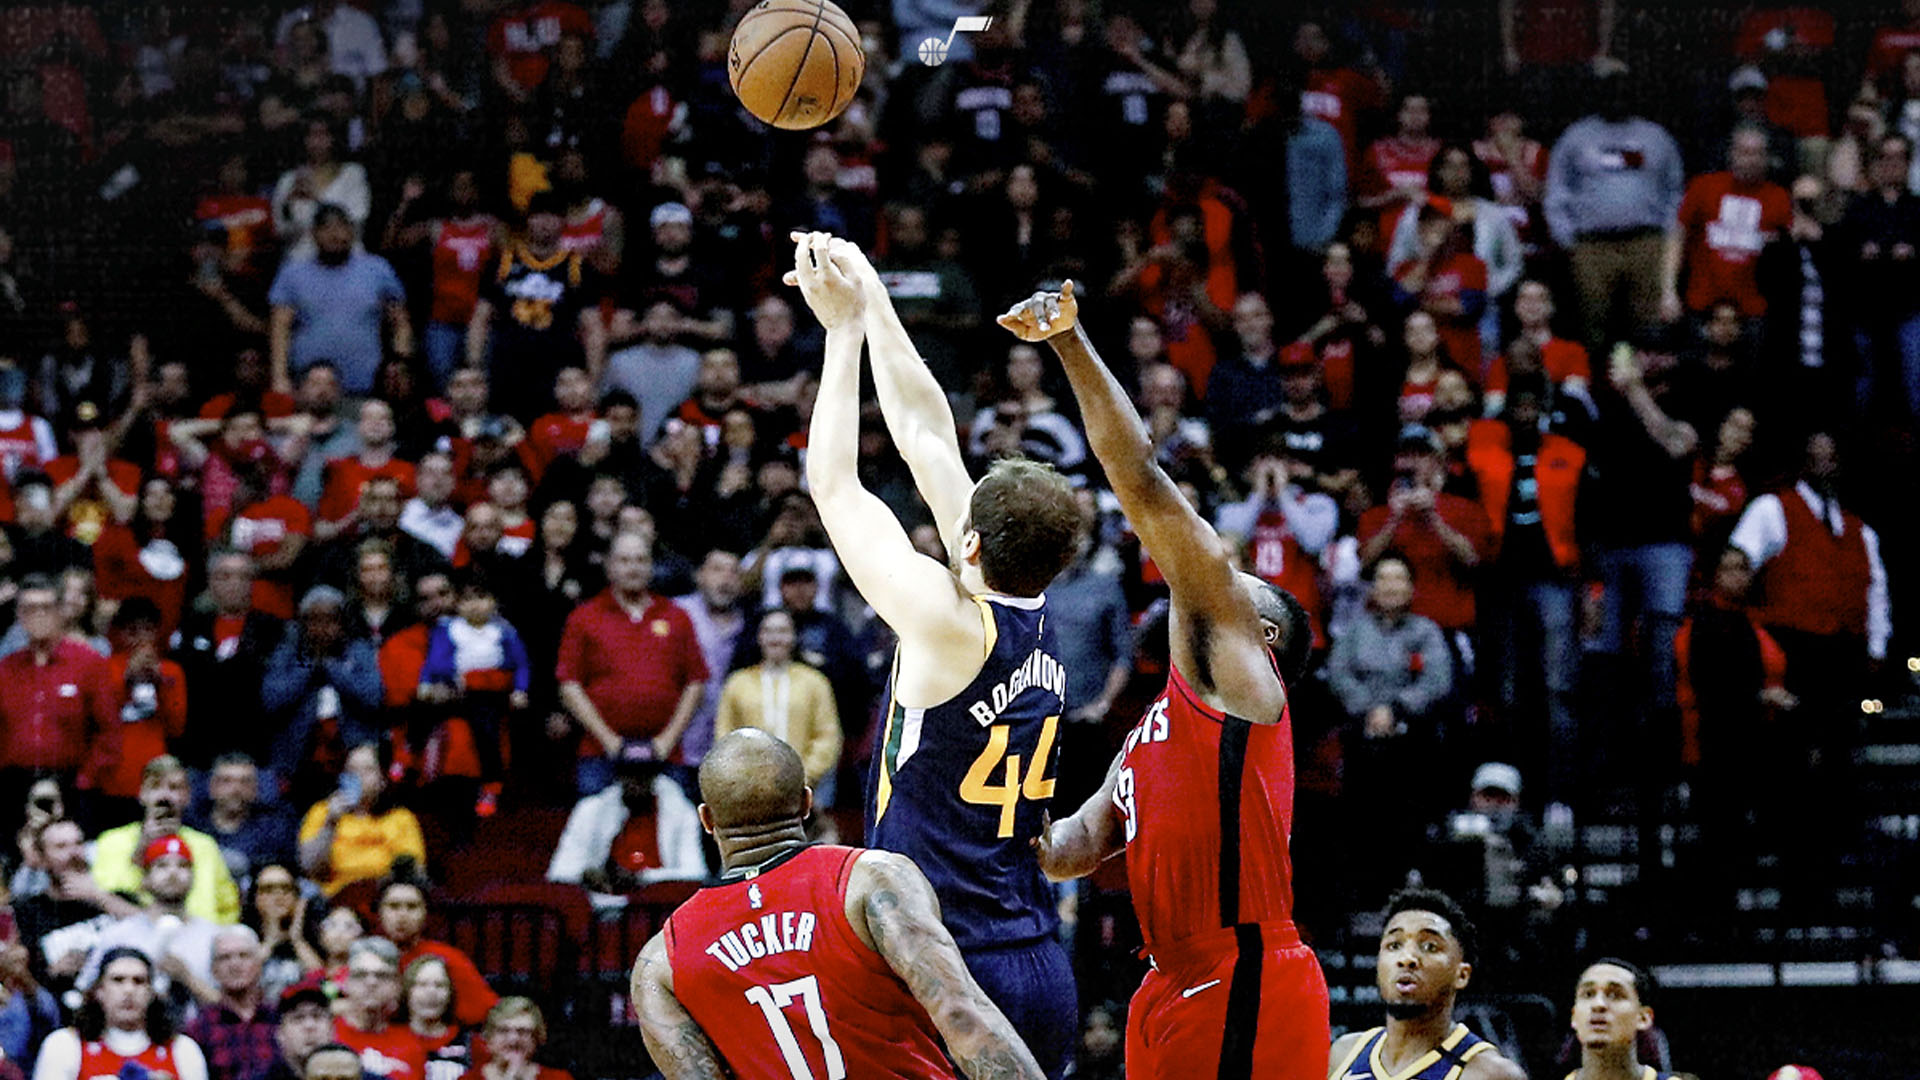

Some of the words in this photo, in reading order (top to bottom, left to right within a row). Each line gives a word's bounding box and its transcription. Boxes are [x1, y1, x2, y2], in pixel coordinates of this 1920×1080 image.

[958, 715, 1060, 838] 44
[704, 911, 816, 973] TUCKER
[744, 974, 847, 1080] 17
